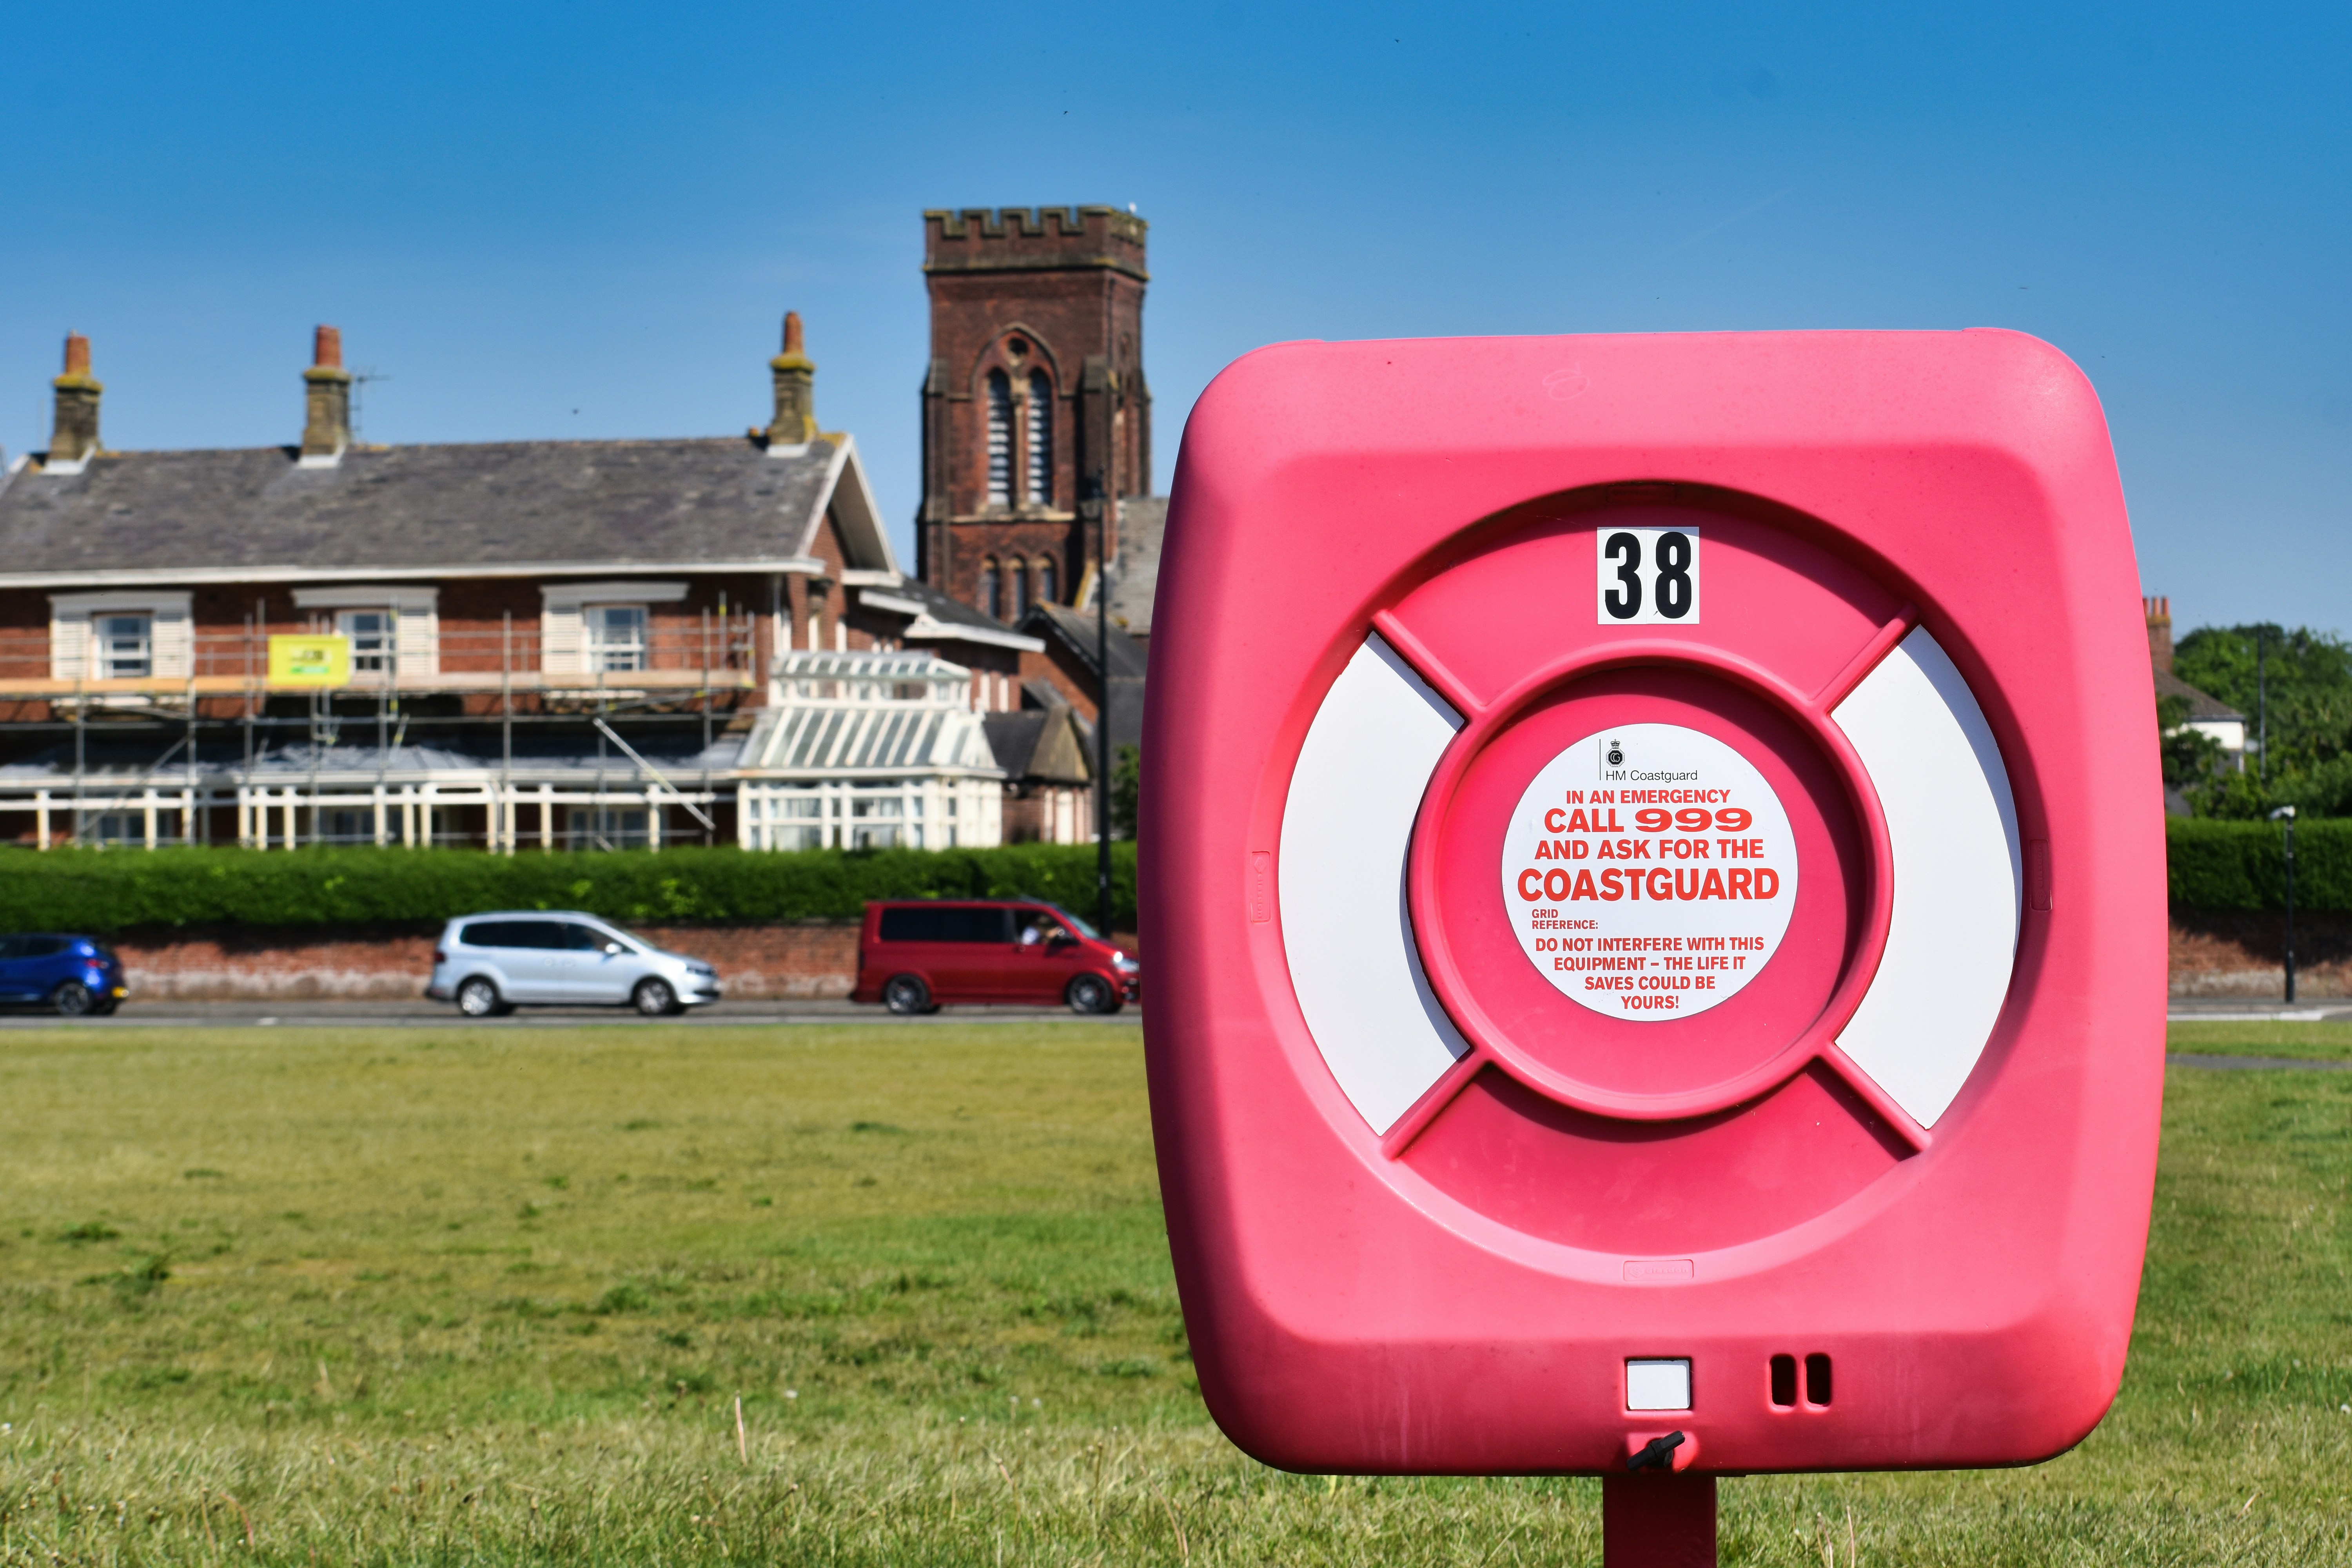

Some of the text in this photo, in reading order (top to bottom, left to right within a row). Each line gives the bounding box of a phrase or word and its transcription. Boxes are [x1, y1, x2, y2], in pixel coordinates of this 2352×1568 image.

[1605, 532, 1692, 619] 38
[1606, 770, 1697, 783] HM Coastguard
[1566, 789, 1731, 804] IN AN EMERGENCY
[1544, 808, 1752, 833] CALL 999
[1534, 838, 1764, 860] AND ASK FOR THE
[1517, 867, 1779, 902] COASTGUARD
[1532, 909, 1558, 918] GRID
[1532, 920, 1598, 929] REFERENCE:
[1536, 936, 1764, 952] DO NOT INTERFERE WITH THIS
[1554, 957, 1646, 972] EQUIPMENT
[1664, 956, 1693, 970] THE
[1697, 956, 1729, 970] LIFE
[1733, 956, 1746, 969] IT
[1584, 976, 1715, 990] SAVES COULD BE
[1621, 995, 1679, 1010] YOURS!
